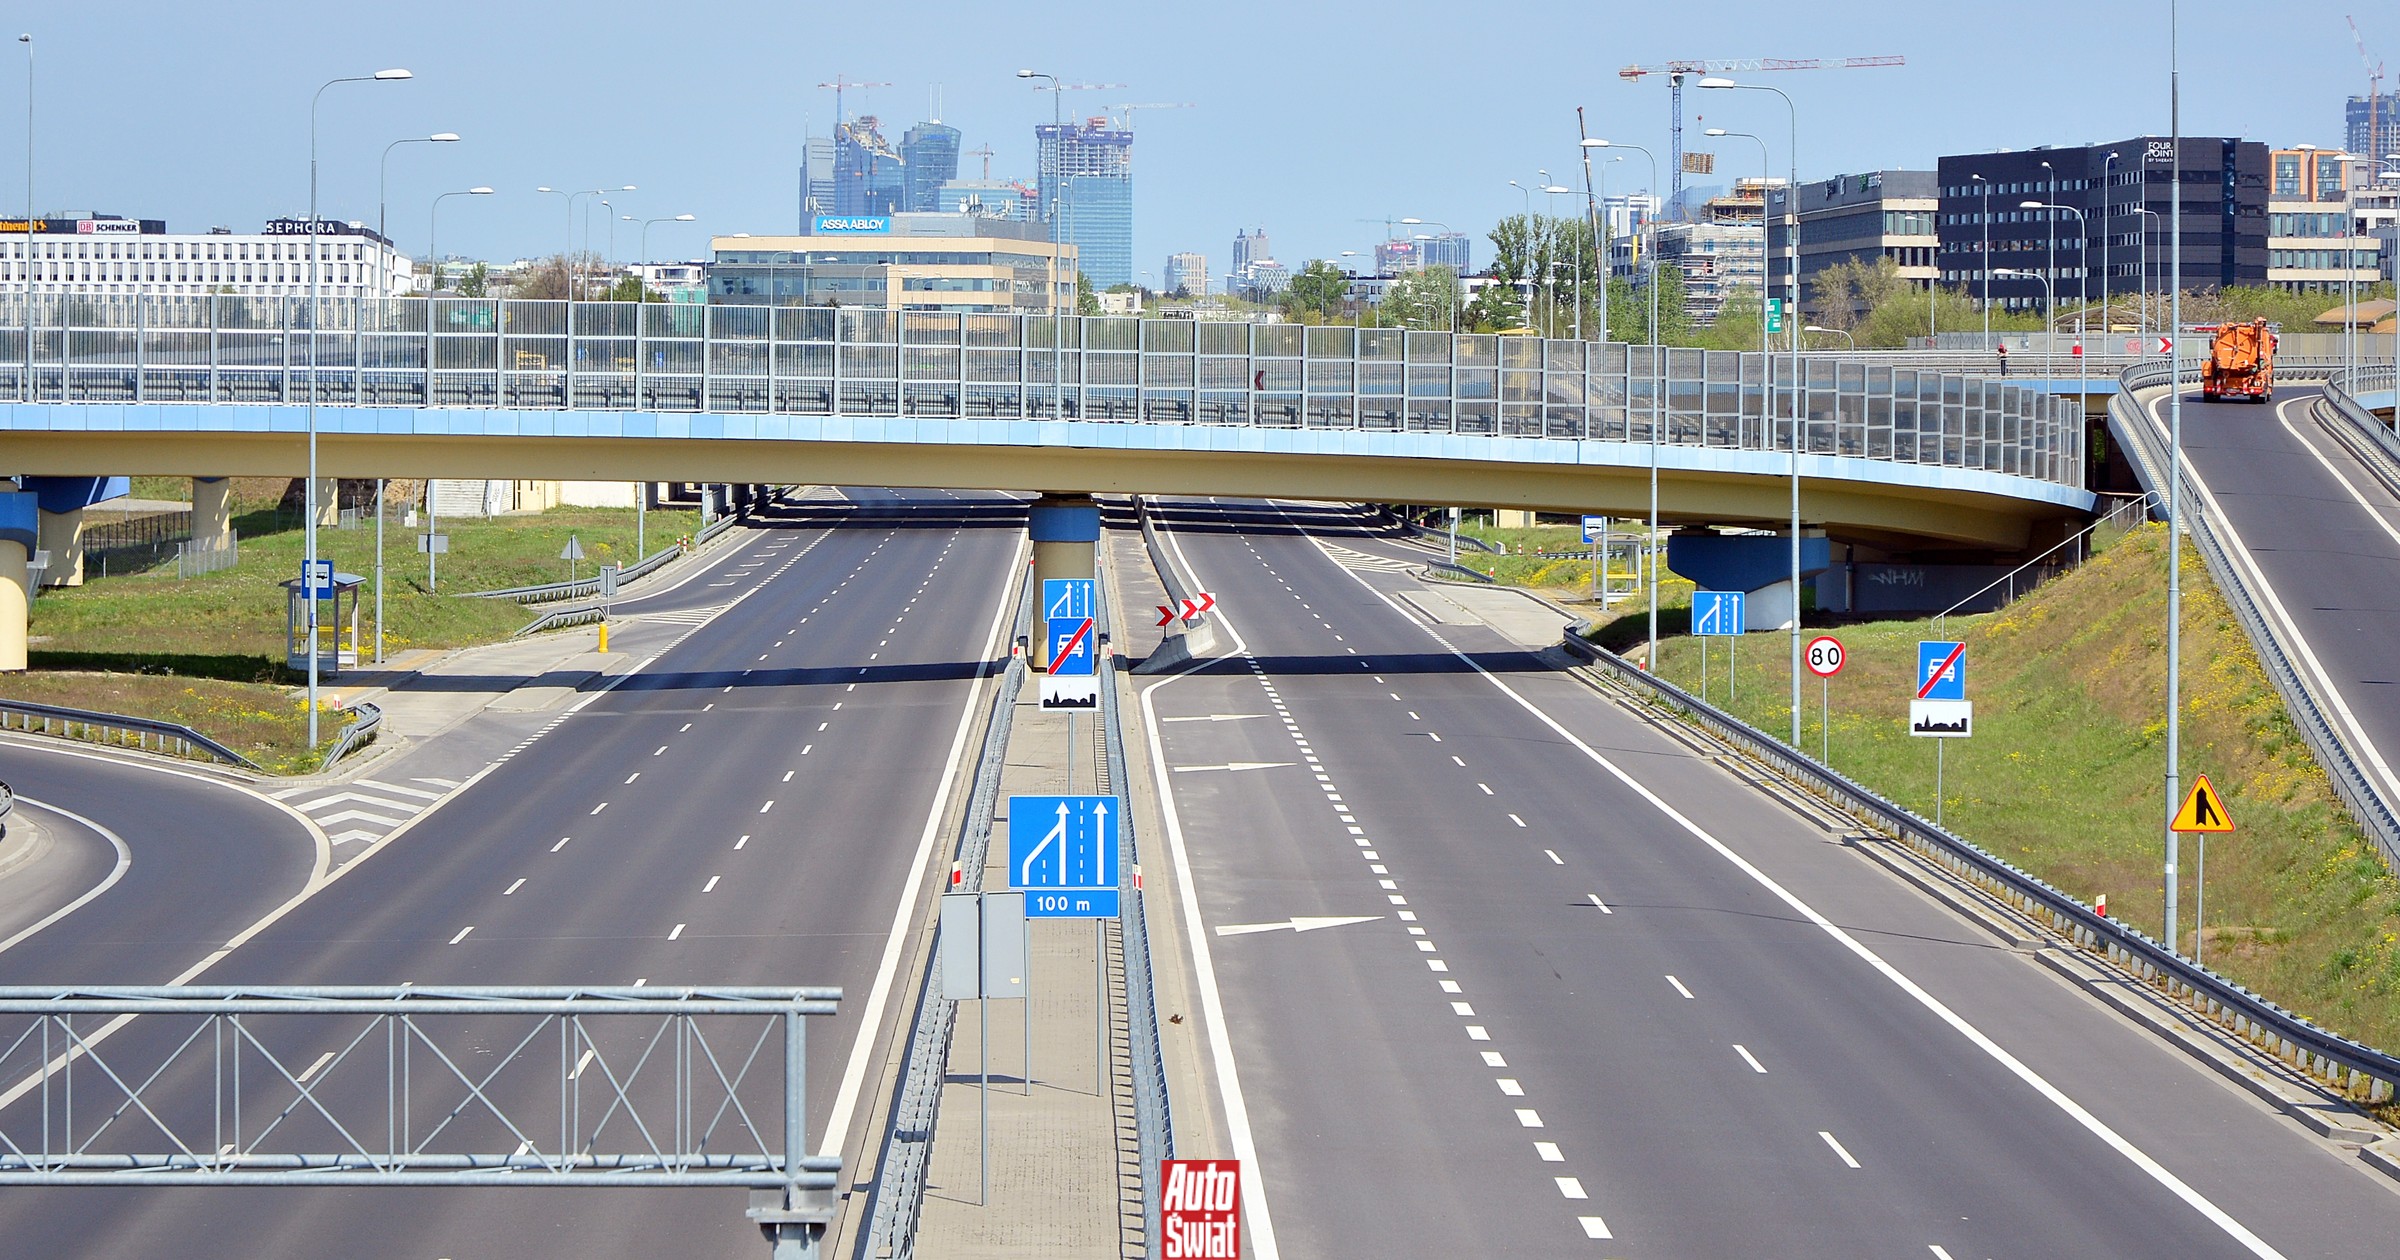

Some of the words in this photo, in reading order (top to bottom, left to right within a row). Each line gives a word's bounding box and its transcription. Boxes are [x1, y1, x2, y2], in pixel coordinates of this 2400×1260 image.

[2148, 141, 2171, 150] FOUR
[96, 223, 137, 232] SCHENKER
[265, 222, 336, 234] SEPHORA
[821, 219, 849, 230] ASSA
[850, 219, 884, 230] ABLOY
[1811, 647, 1840, 666] 80
[1037, 896, 1068, 912] 100
[1076, 900, 1091, 912] m
